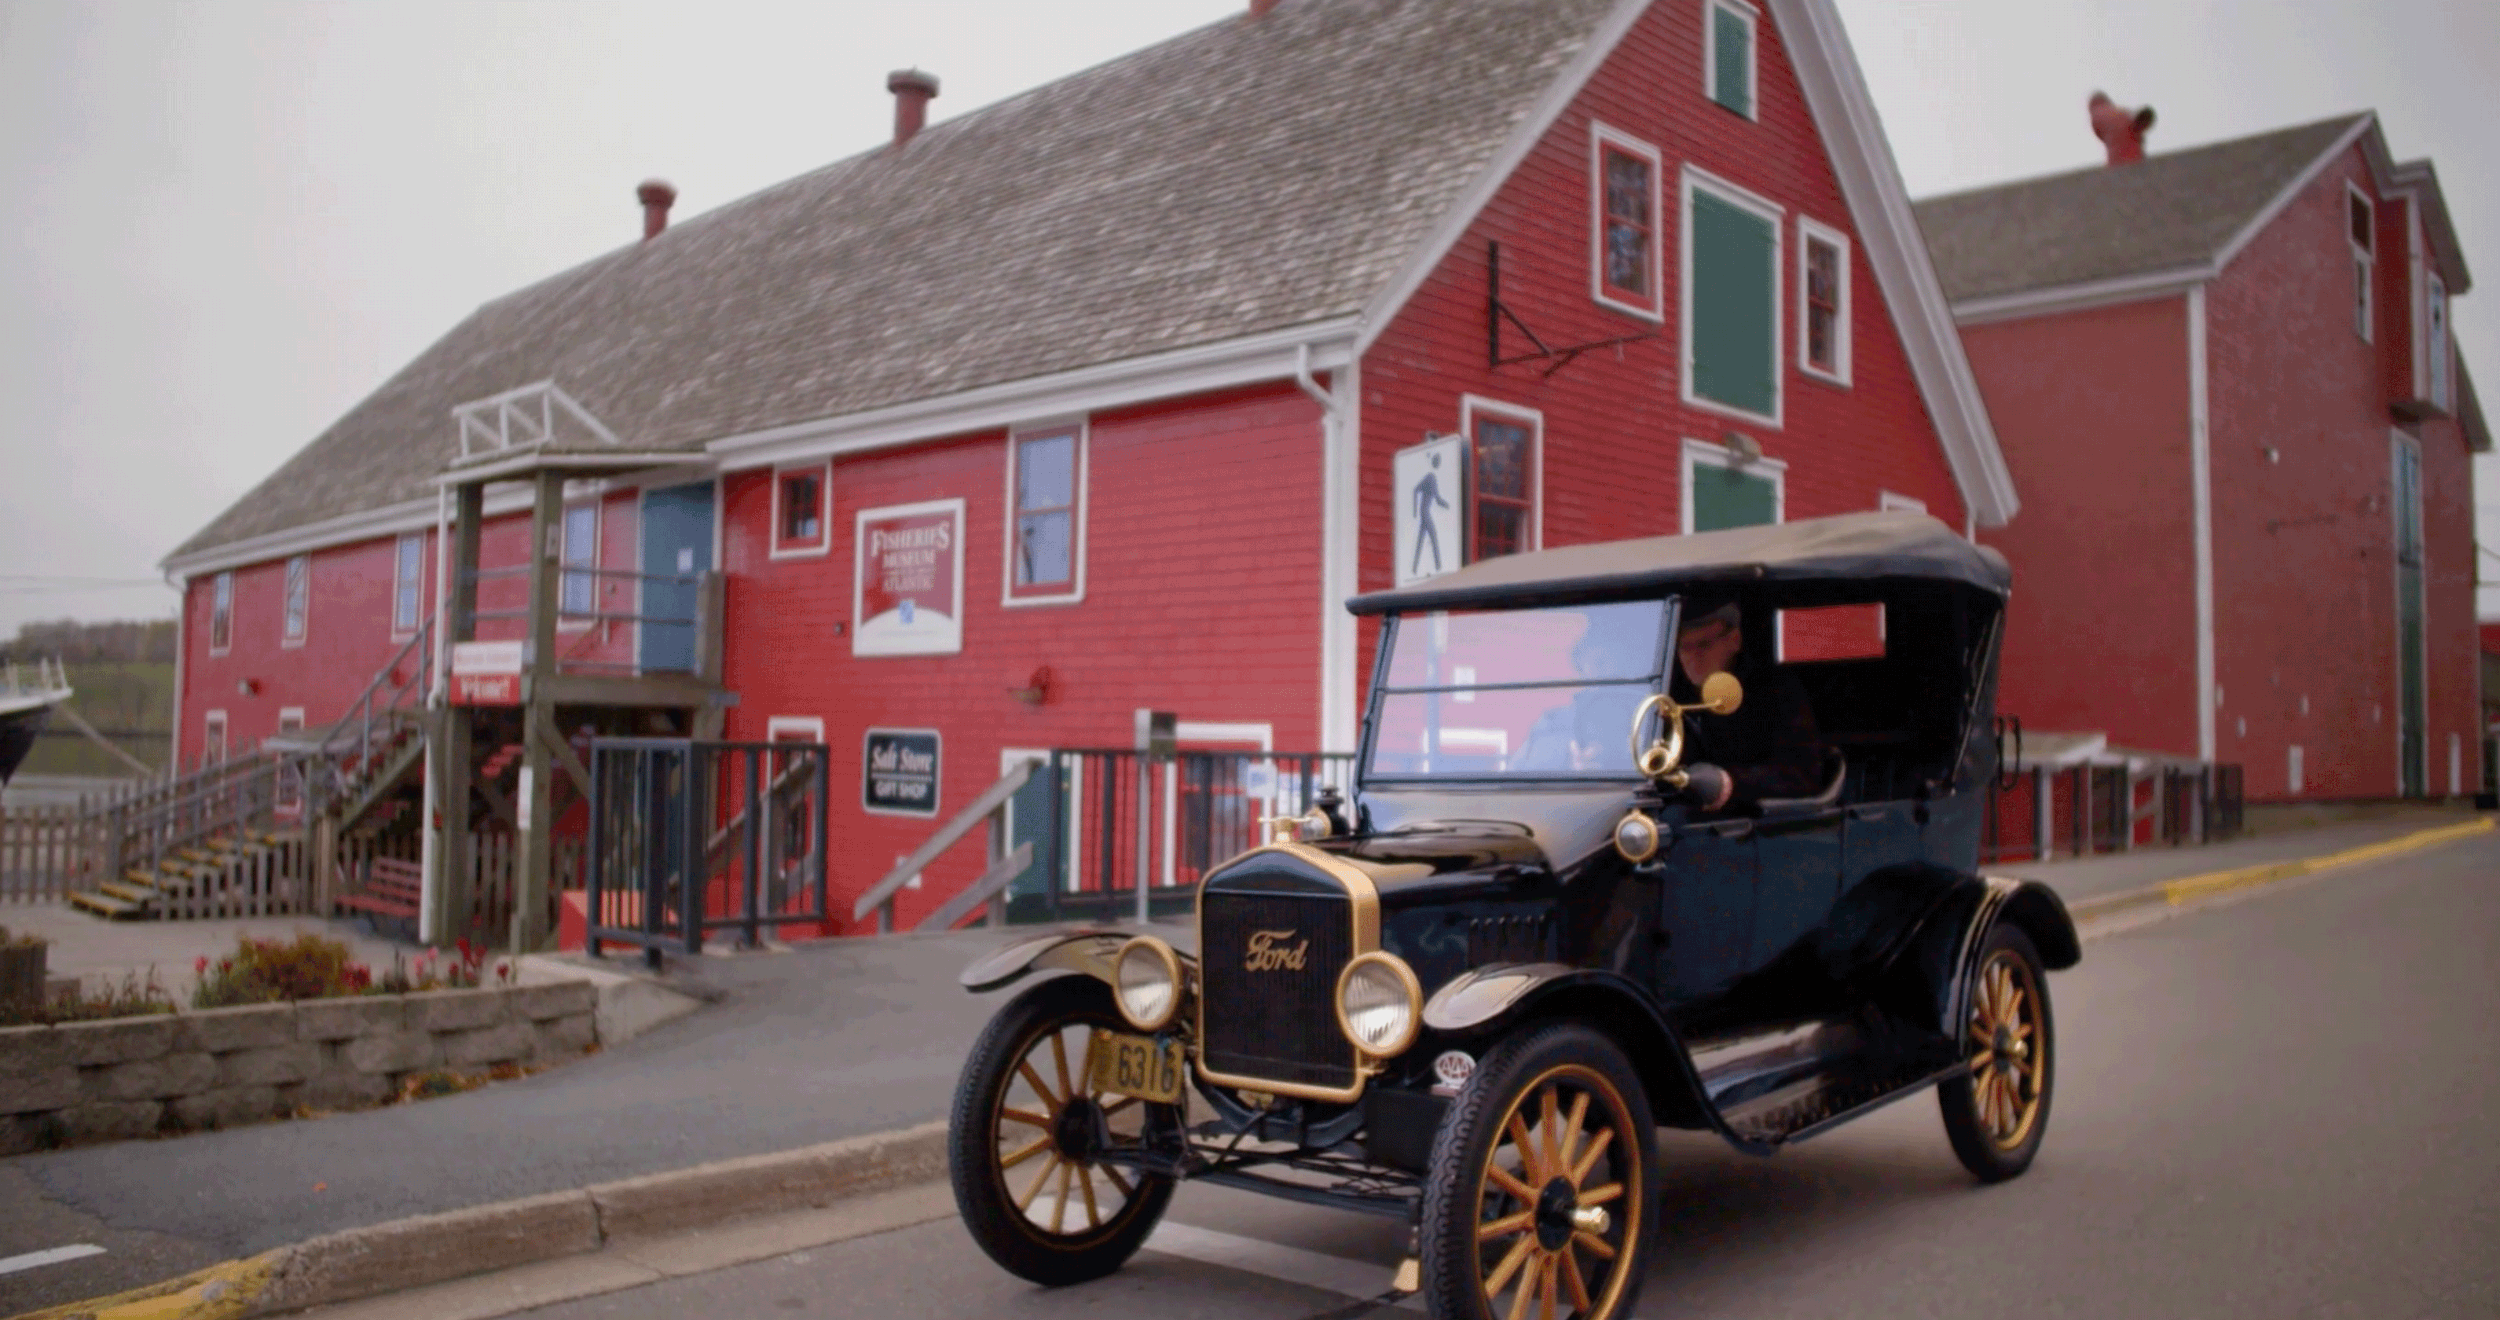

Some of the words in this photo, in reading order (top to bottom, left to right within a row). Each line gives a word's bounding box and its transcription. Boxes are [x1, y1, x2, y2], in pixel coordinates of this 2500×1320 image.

[871, 521, 950, 557] FISHERIES
[882, 549, 936, 568] MUSEUM
[871, 741, 897, 770] Salt
[899, 746, 933, 772] Store
[875, 781, 896, 797] GIFT
[899, 782, 927, 799] SHOP
[1245, 929, 1309, 972] Ford
[1118, 1043, 1177, 1094] 6316
